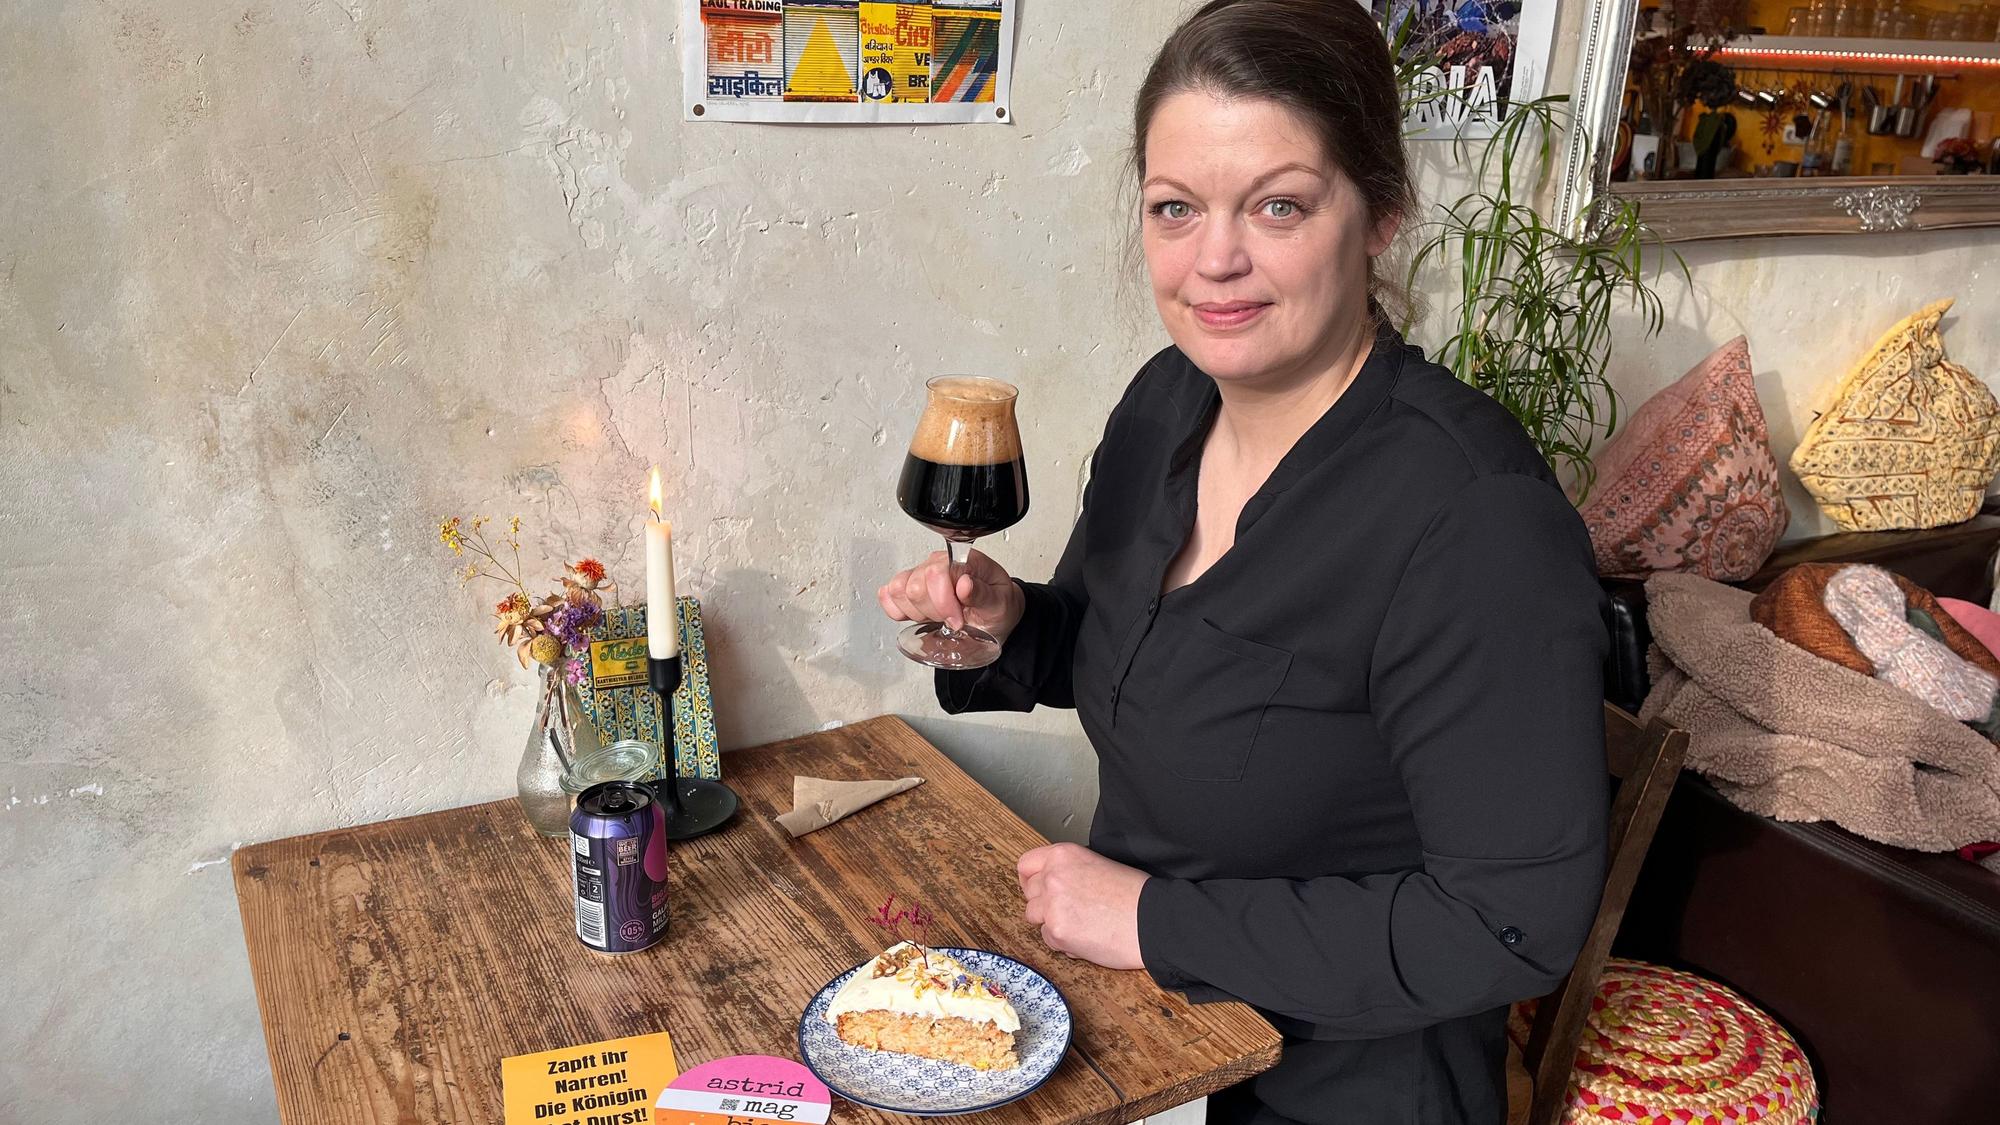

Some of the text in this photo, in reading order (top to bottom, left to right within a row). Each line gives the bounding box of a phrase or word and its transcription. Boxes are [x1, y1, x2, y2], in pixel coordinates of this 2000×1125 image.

[733, 0, 782, 12] TRADING
[708, 71, 783, 98] साइकिल
[908, 75, 930, 87] BR
[592, 885, 598, 894] 2
[548, 1051, 628, 1075] Zapft ihr
[555, 1069, 628, 1094] Narren!
[707, 1077, 804, 1098] astrid
[534, 1088, 648, 1119] Die Königin
[742, 1100, 799, 1120] mag
[586, 1108, 648, 1125] Durst!
